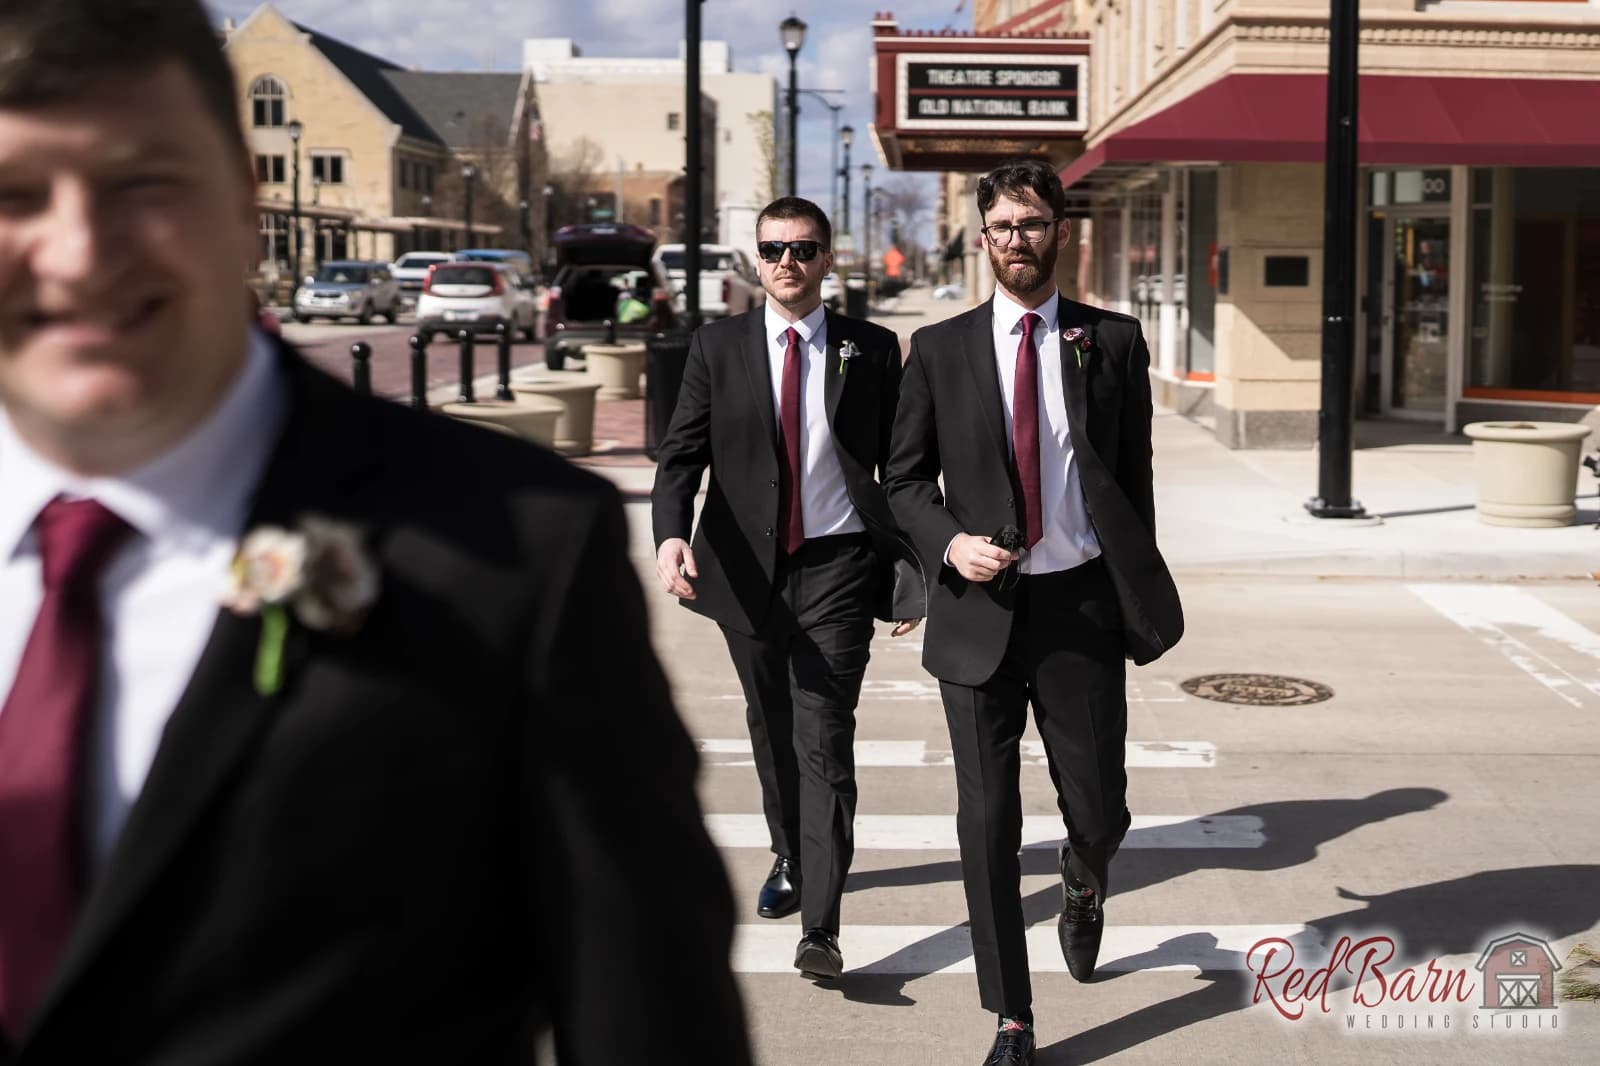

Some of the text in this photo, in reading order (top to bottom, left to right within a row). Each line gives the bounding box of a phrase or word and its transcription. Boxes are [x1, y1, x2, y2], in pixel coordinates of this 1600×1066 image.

[926, 69, 1061, 87] THEATRE SPONSOR
[918, 98, 1069, 116] OLD NATIONAL BANK
